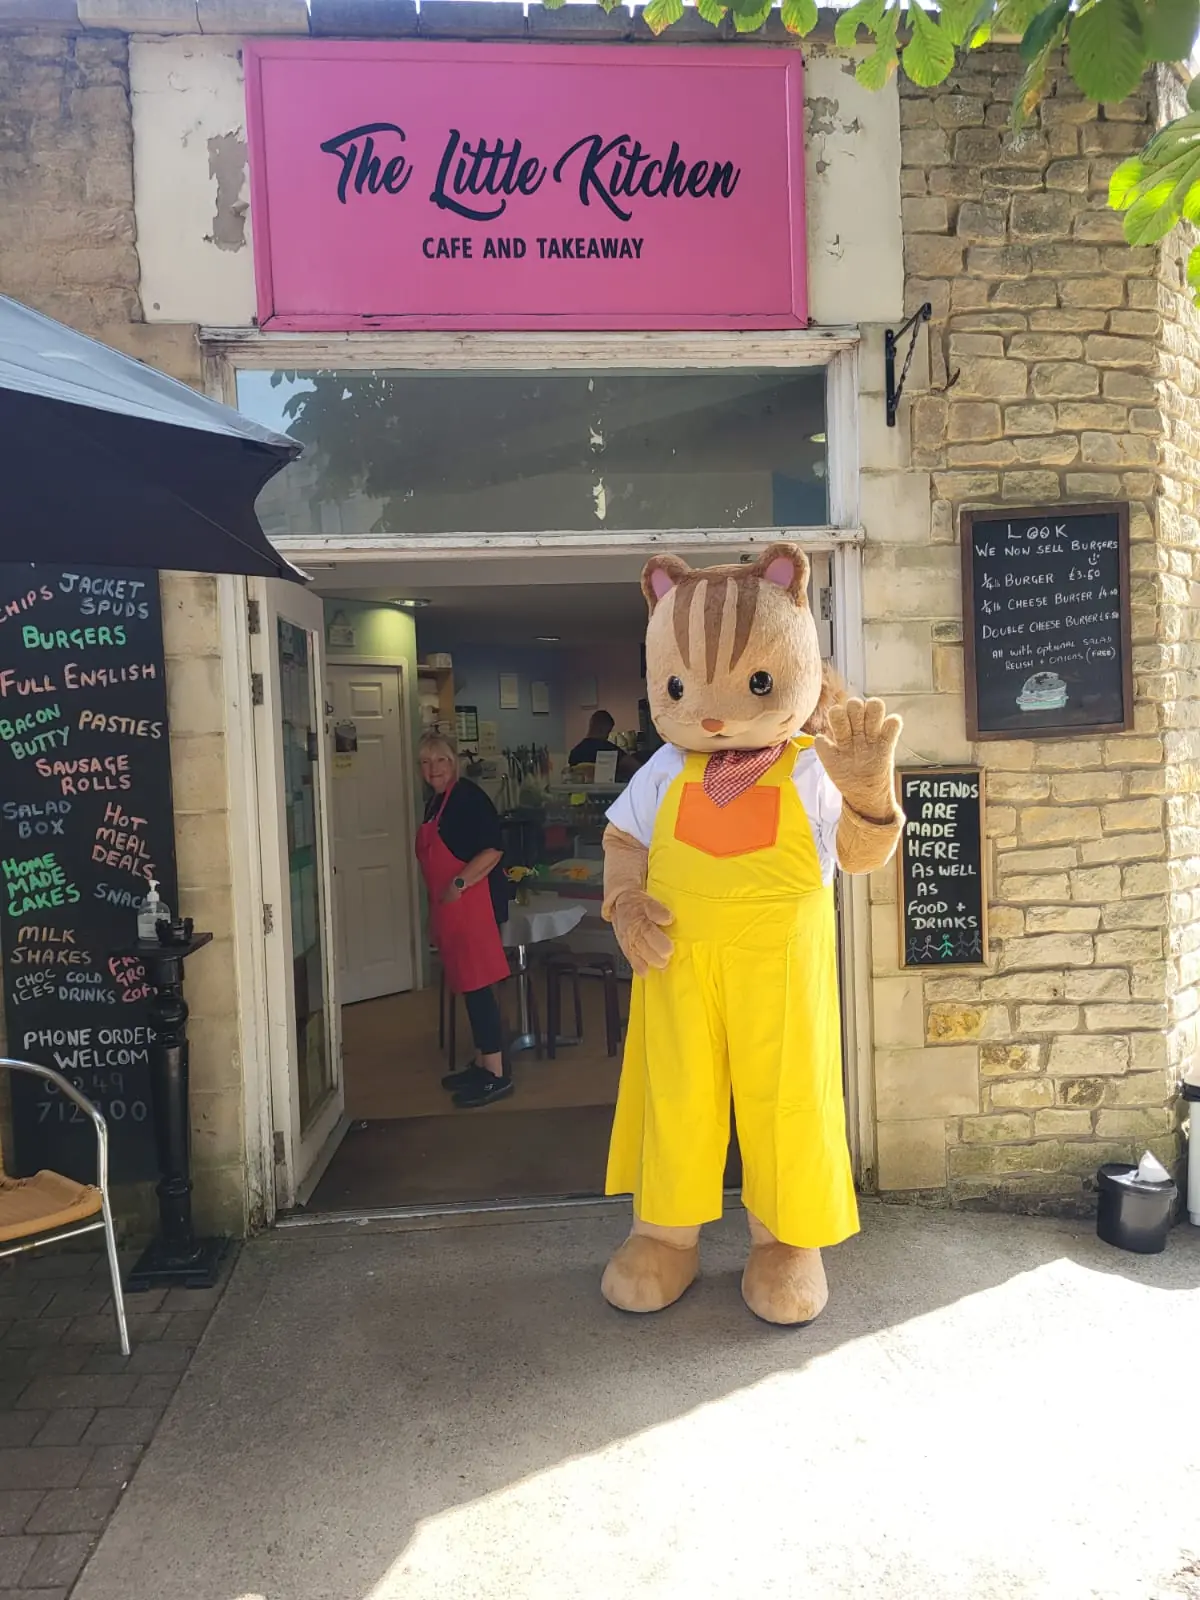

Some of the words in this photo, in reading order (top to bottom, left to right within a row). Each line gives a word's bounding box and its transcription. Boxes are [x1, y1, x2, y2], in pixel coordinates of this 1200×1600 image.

[320, 122, 413, 204] The
[429, 129, 546, 221] Little
[553, 134, 741, 221] Kitchen
[422, 237, 473, 259] CAFE
[483, 237, 527, 259] AND
[539, 237, 645, 259] TAKEAWAY
[1007, 523, 1068, 540] LOOK
[975, 542, 996, 558] WE
[1004, 545, 1030, 556] NOW
[1036, 544, 1063, 554] SELL
[1071, 540, 1118, 551] BURGERS
[58, 572, 146, 600] JACKET
[1005, 573, 1055, 587] BURGER
[1068, 567, 1101, 581] £3.50
[79, 597, 150, 620] SPUDS
[1007, 597, 1048, 610] CHEESE
[1054, 590, 1093, 605] BURGER
[982, 622, 1025, 640] DOUBLE
[1029, 619, 1061, 633] CHEESE
[1065, 612, 1098, 627] BURGER
[22, 625, 127, 650] BURGERS
[1009, 643, 1033, 657] with
[1005, 659, 1034, 671] RELISH
[0, 669, 56, 697] FULL
[64, 662, 156, 689] ENGLISH
[0, 703, 61, 741] BACON
[78, 709, 163, 739] PASTIES
[10, 725, 70, 760] BUTTY
[35, 754, 131, 777] SAUSAGE
[61, 774, 132, 796] ROLLS
[906, 780, 979, 799] FRIENDS
[3, 800, 72, 820] SALAD
[104, 801, 148, 831] HOT
[922, 802, 958, 820] ARE
[18, 819, 65, 840] BOX
[906, 822, 957, 838] MADE
[95, 827, 150, 860] MEAL
[908, 839, 960, 860] HERE
[1, 852, 57, 880] HOME
[91, 844, 157, 881] DEALS
[911, 862, 935, 879] AS
[938, 863, 976, 877] WELL
[7, 866, 67, 900] MADE
[917, 882, 938, 897] AS
[7, 882, 81, 917] CAKES
[93, 882, 147, 909] SNAC
[907, 900, 948, 916] FOOD
[18, 925, 76, 944] MILK
[10, 946, 92, 966] SHAKES
[15, 968, 57, 989] CHOC
[66, 971, 103, 984] COLD
[115, 965, 146, 987] GRO
[12, 981, 55, 1005] ICES
[58, 986, 116, 1004] DRINKS
[23, 1028, 93, 1050] PHONE
[98, 1026, 158, 1045] ORDER
[53, 1049, 149, 1070] WELCOM
[44, 1071, 125, 1095] 0249
